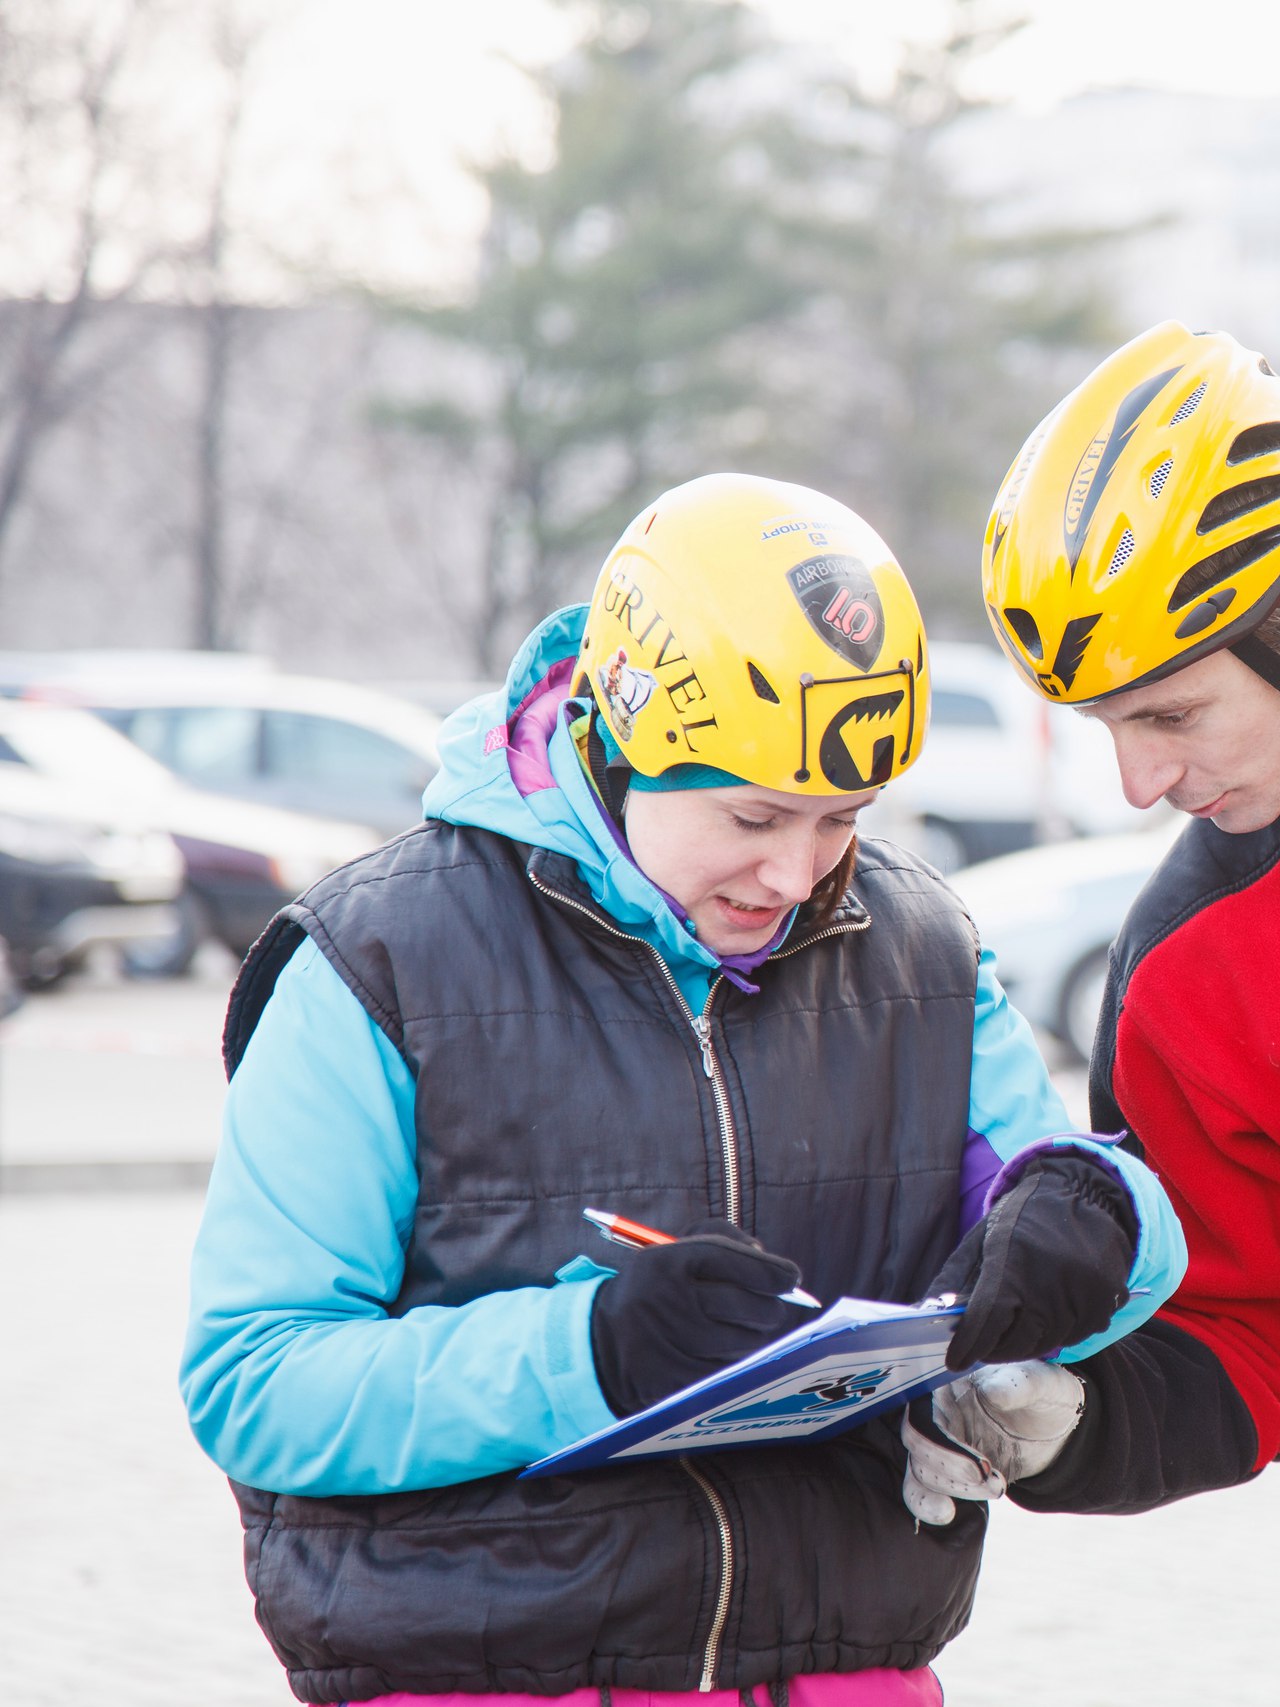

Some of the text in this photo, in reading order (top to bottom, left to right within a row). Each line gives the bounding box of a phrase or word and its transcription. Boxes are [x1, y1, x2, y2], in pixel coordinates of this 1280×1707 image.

[1067, 432, 1110, 524] GRIVEL
[604, 572, 719, 754] GRIVEL
[658, 1414, 838, 1442] ICECLIMBING
